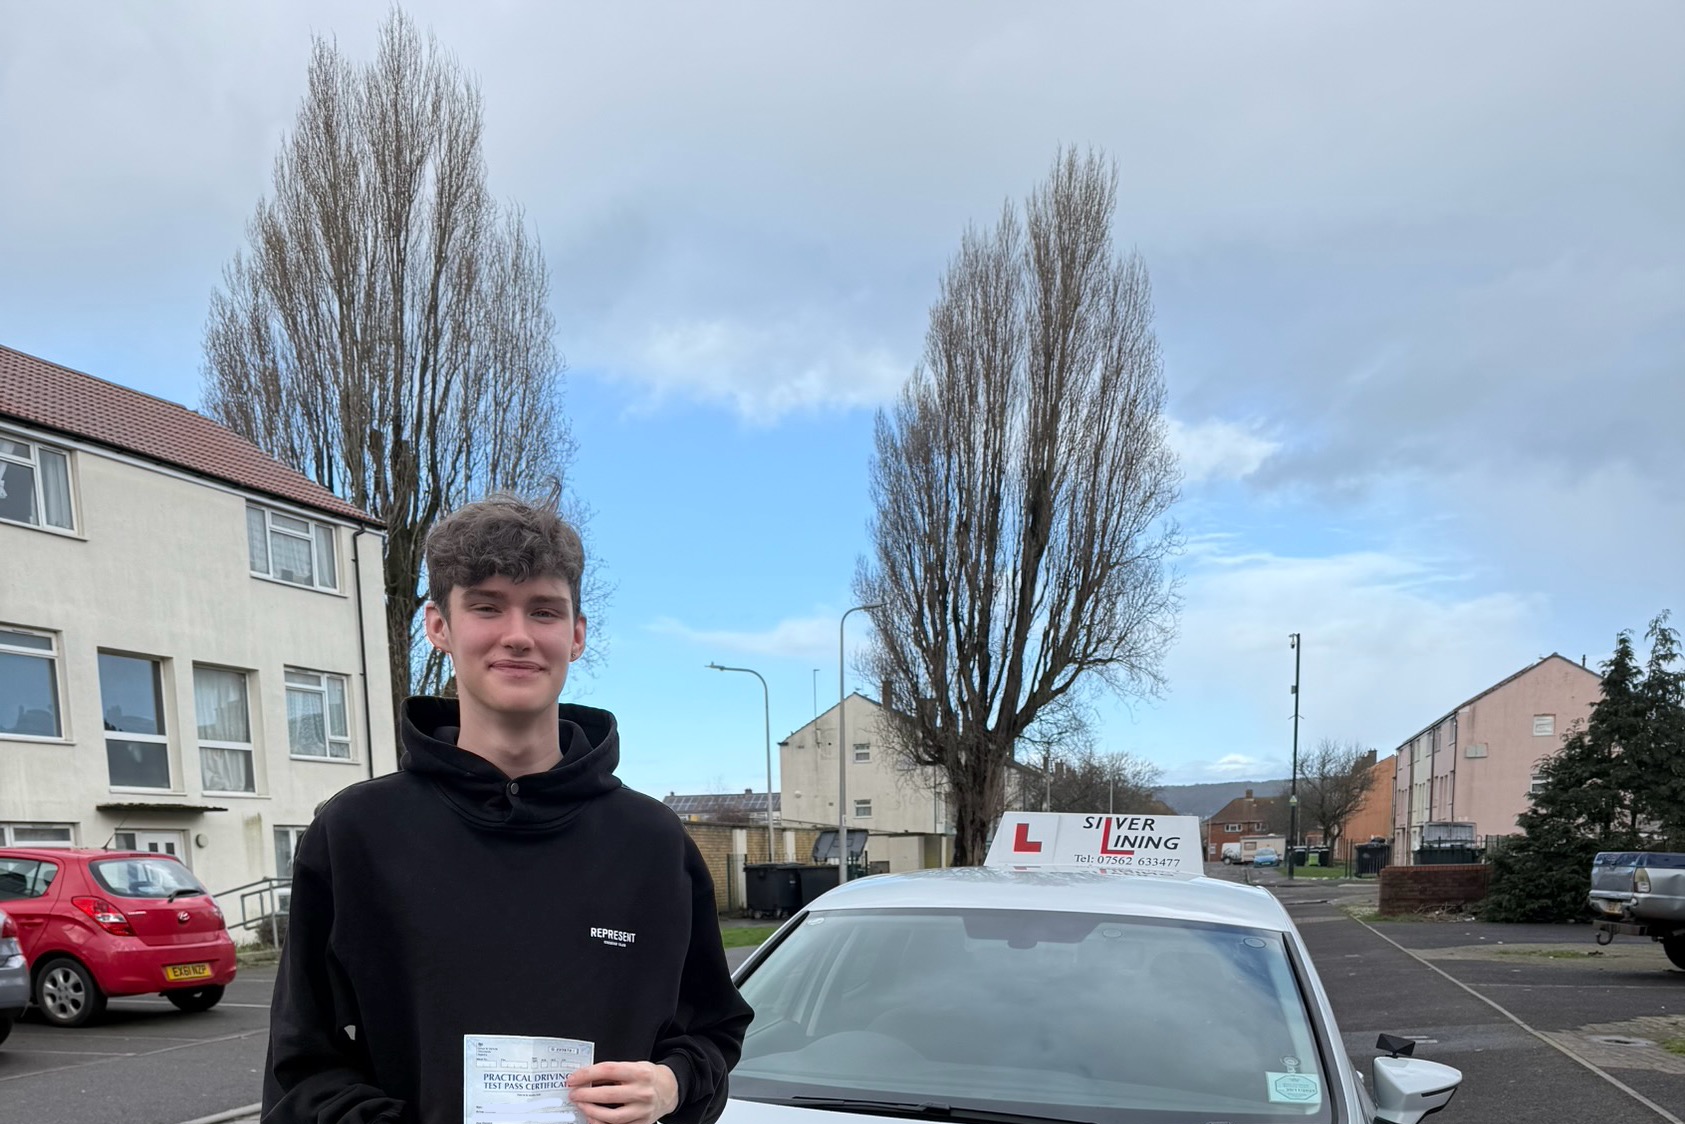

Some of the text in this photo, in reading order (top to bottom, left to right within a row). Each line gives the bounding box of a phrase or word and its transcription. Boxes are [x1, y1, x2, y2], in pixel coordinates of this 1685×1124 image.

[1083, 816, 1155, 838] SILVER
[1100, 829, 1181, 855] LINING
[1074, 854, 1181, 868] Tel: 07562 633477
[590, 927, 636, 943] REPRESENT
[483, 1073, 532, 1082] PRACTICAL
[504, 1082, 524, 1090] PASS
[525, 1081, 568, 1090] CERTIFICAT
